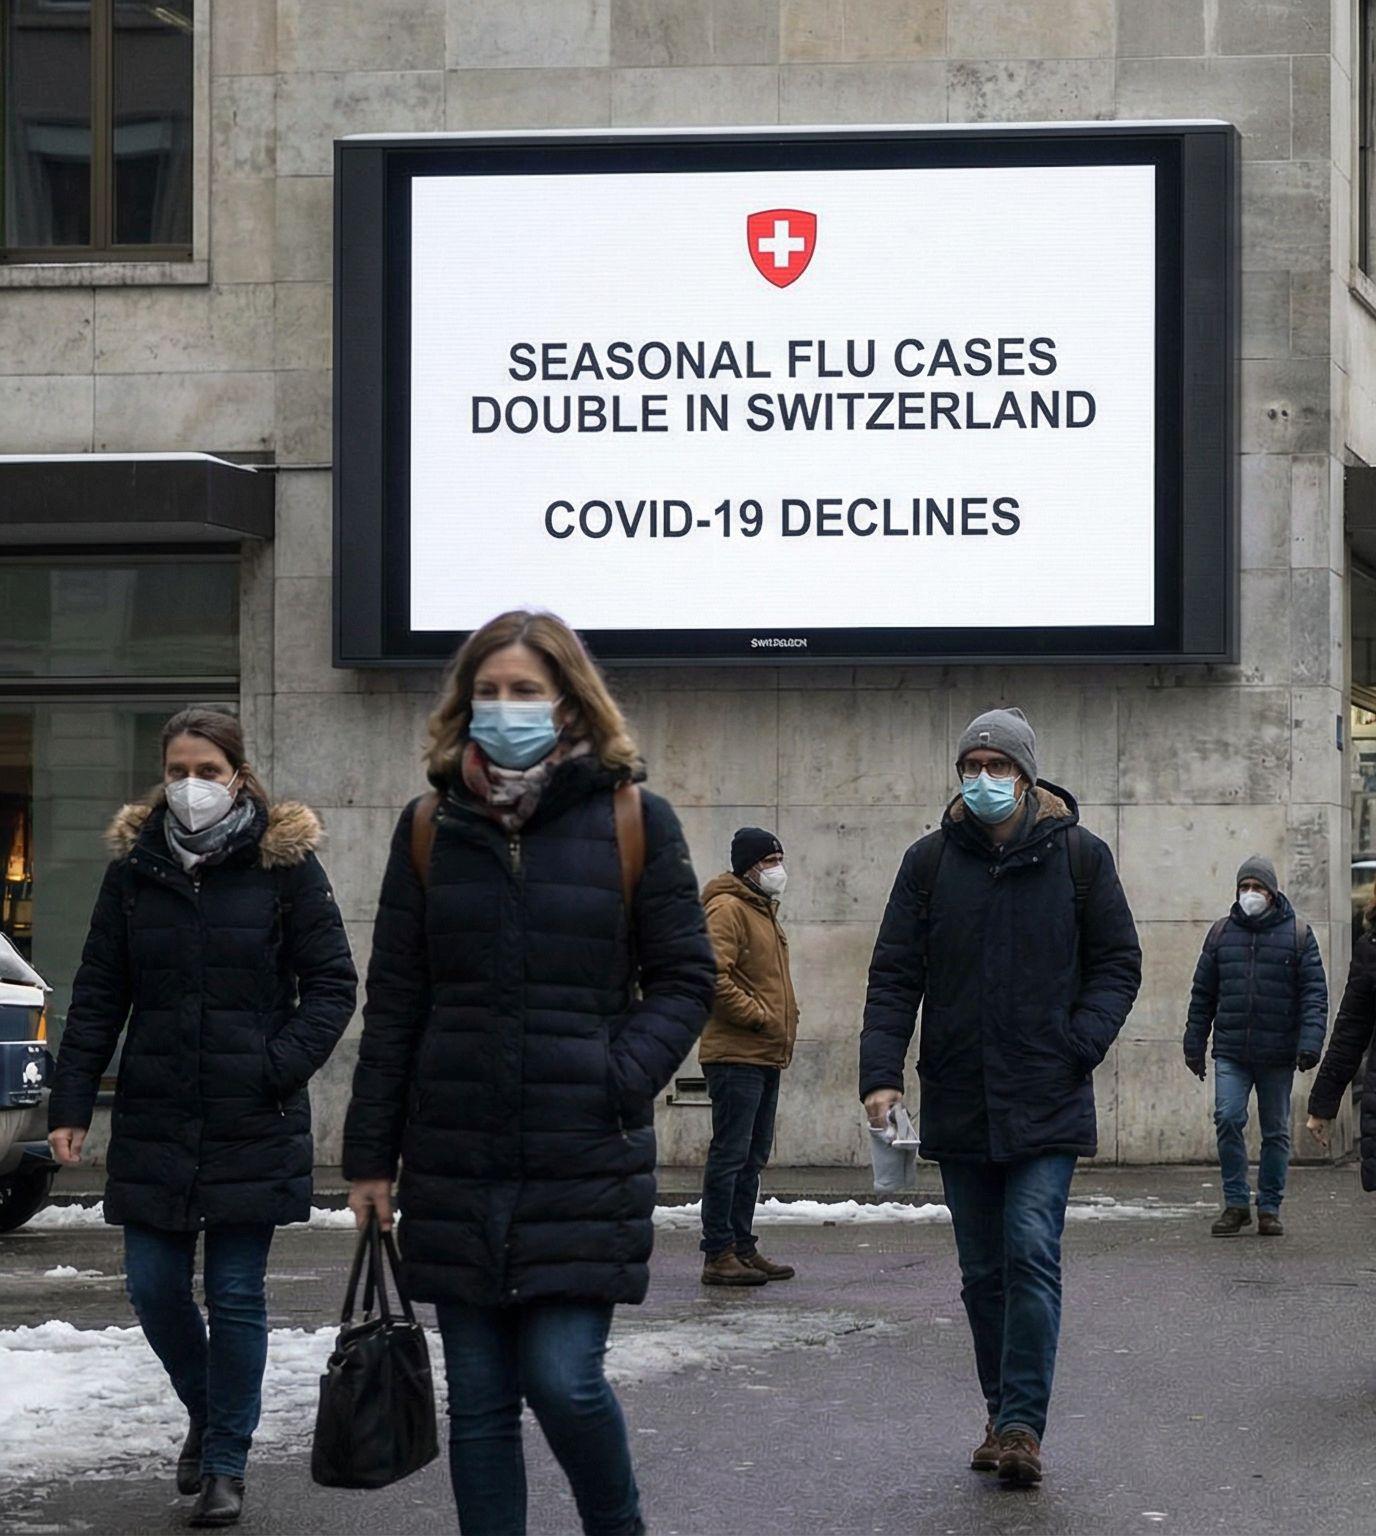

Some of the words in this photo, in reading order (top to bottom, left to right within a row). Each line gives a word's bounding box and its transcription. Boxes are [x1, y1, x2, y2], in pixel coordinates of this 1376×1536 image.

[509, 340, 771, 382] SEASONAL
[789, 339, 875, 378] FLU
[895, 336, 1058, 378] CASES
[472, 394, 668, 435] DOUBLE
[687, 393, 728, 432] IN
[747, 390, 1096, 432] SWITZERLAND
[545, 498, 762, 539] COVID-19
[782, 496, 1021, 537] DECLINES
